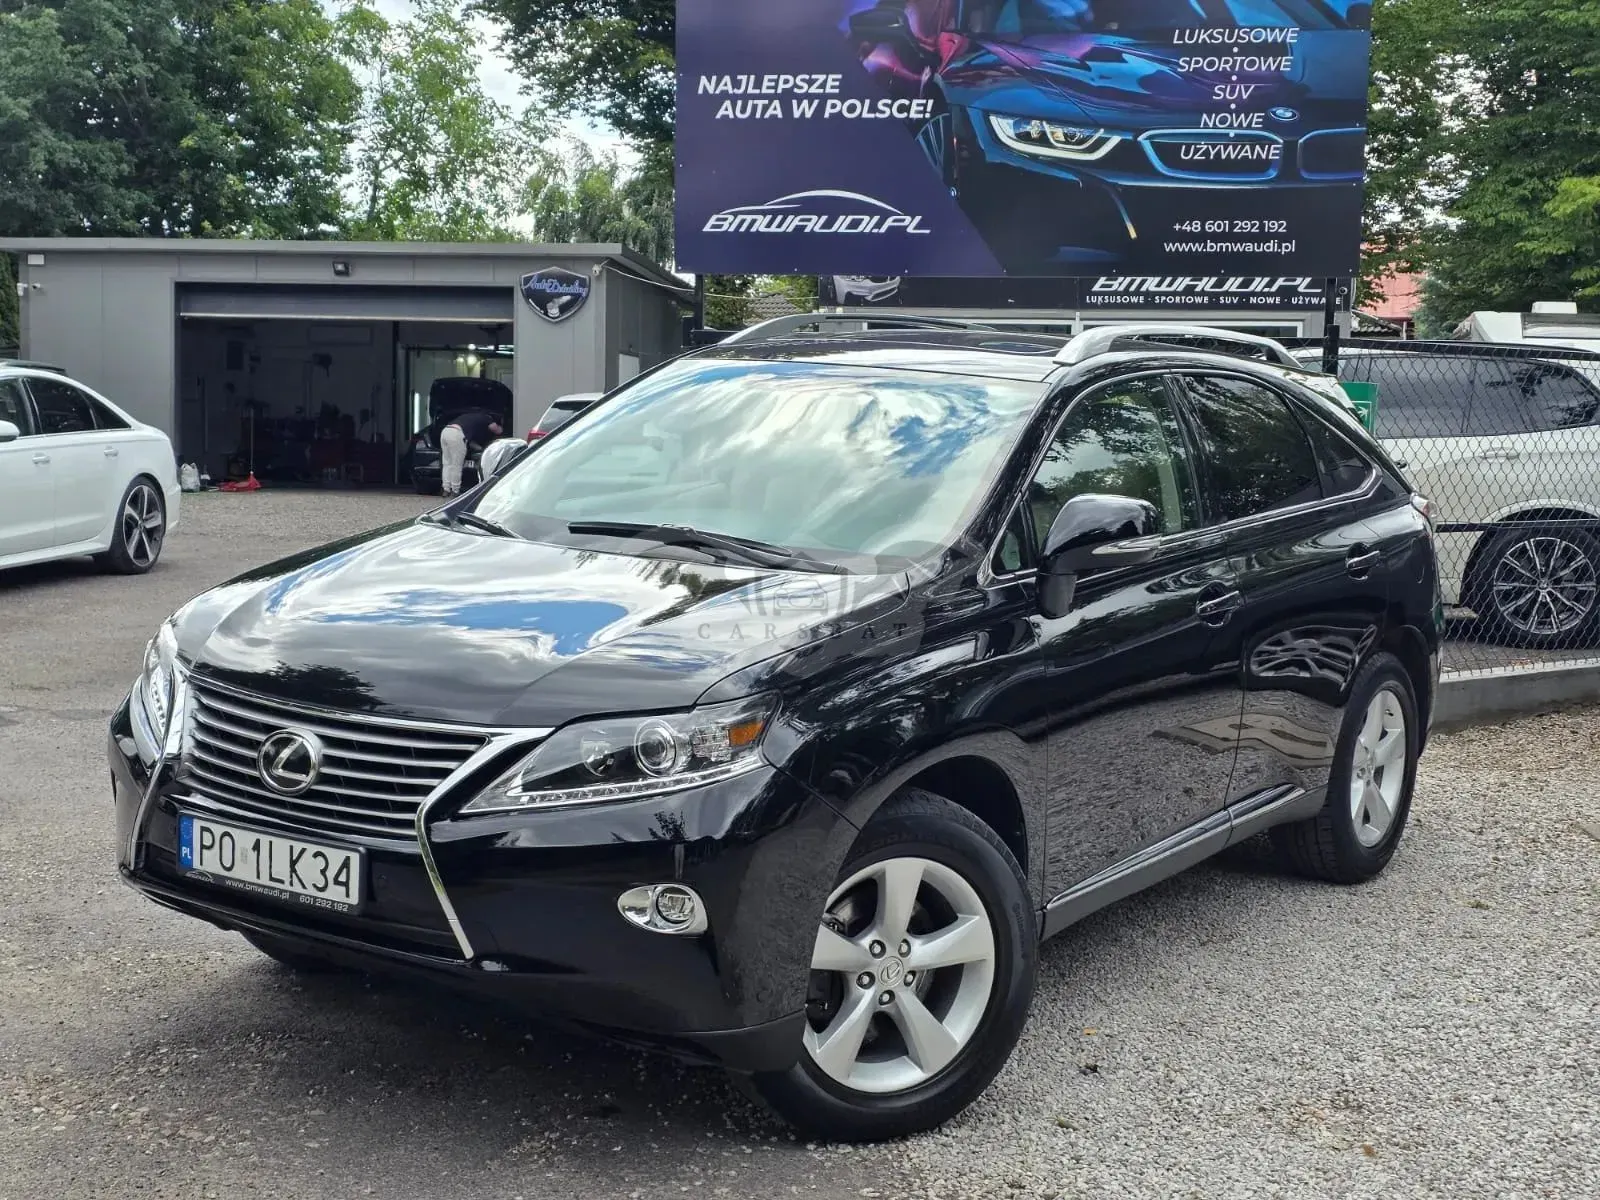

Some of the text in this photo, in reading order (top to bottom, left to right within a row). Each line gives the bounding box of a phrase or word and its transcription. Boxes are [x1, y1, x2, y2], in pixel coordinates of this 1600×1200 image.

[1172, 28, 1299, 44] LUKSUSOWE
[1177, 56, 1294, 72] SPORTOWE
[698, 74, 842, 95] NAJLEPSZE
[1212, 84, 1255, 100] SUV
[715, 99, 934, 119] AUTA W POLSCE!
[1200, 112, 1265, 128] NOWE
[1180, 141, 1283, 160] UŻYWANE
[702, 214, 931, 234] BMWAUDI.PL
[1173, 220, 1287, 233] +48 601 292 192
[1163, 239, 1296, 255] www.bmwaudi.pl
[1086, 295, 1342, 305] LUKSUSOWE SPORTOWE SUV NOWE UŻYWAE
[199, 825, 352, 899] PO 1LK34
[225, 878, 290, 900] www.bmwaudi.pl
[299, 894, 314, 905] 601
[315, 898, 332, 909] 292
[334, 901, 349, 912] 192
